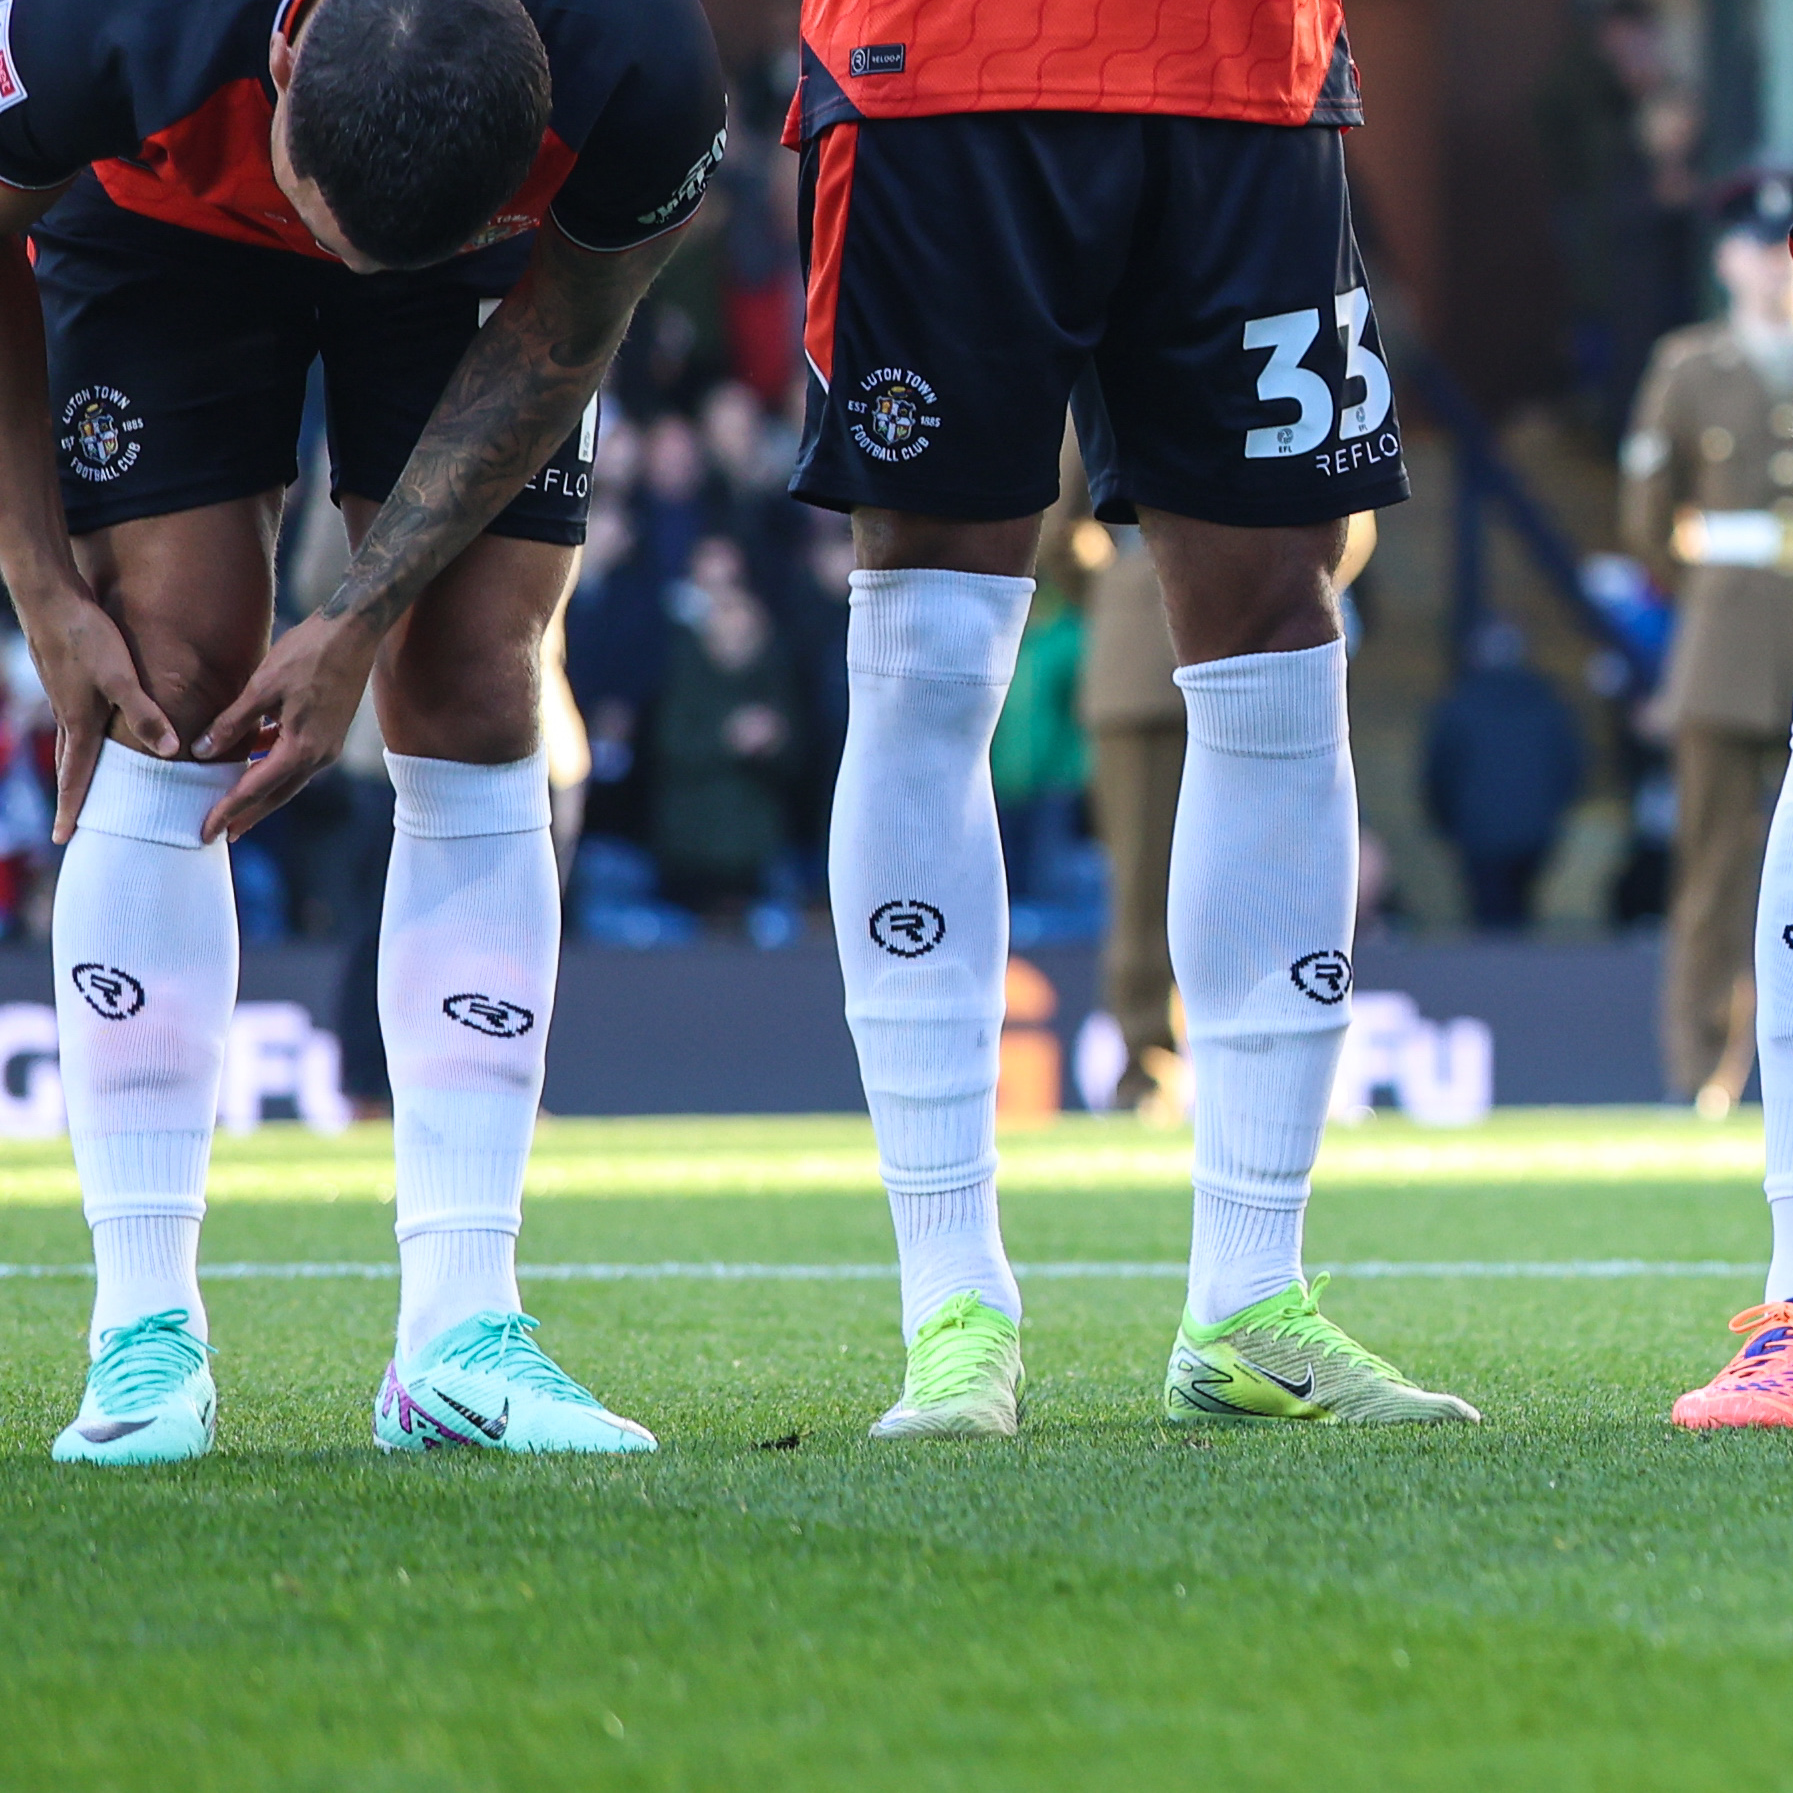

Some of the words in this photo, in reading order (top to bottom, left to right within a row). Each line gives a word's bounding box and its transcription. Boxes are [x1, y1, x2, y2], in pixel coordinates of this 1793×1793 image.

[860, 367, 902, 391] LUTON
[905, 369, 938, 405] TOWN
[1242, 286, 1392, 459] 33
[62, 388, 91, 424] LUTON
[94, 385, 131, 410] TOWN
[847, 399, 868, 414] EST
[61, 435, 75, 451] EST
[70, 456, 120, 482] FOOTBALL
[117, 441, 141, 472] CLUB
[850, 423, 899, 462] FOOTBALL
[901, 436, 930, 461] CLUB
[1278, 444, 1293, 454] EFL
[1315, 432, 1400, 477] REFLO
[524, 468, 589, 498] FLO
